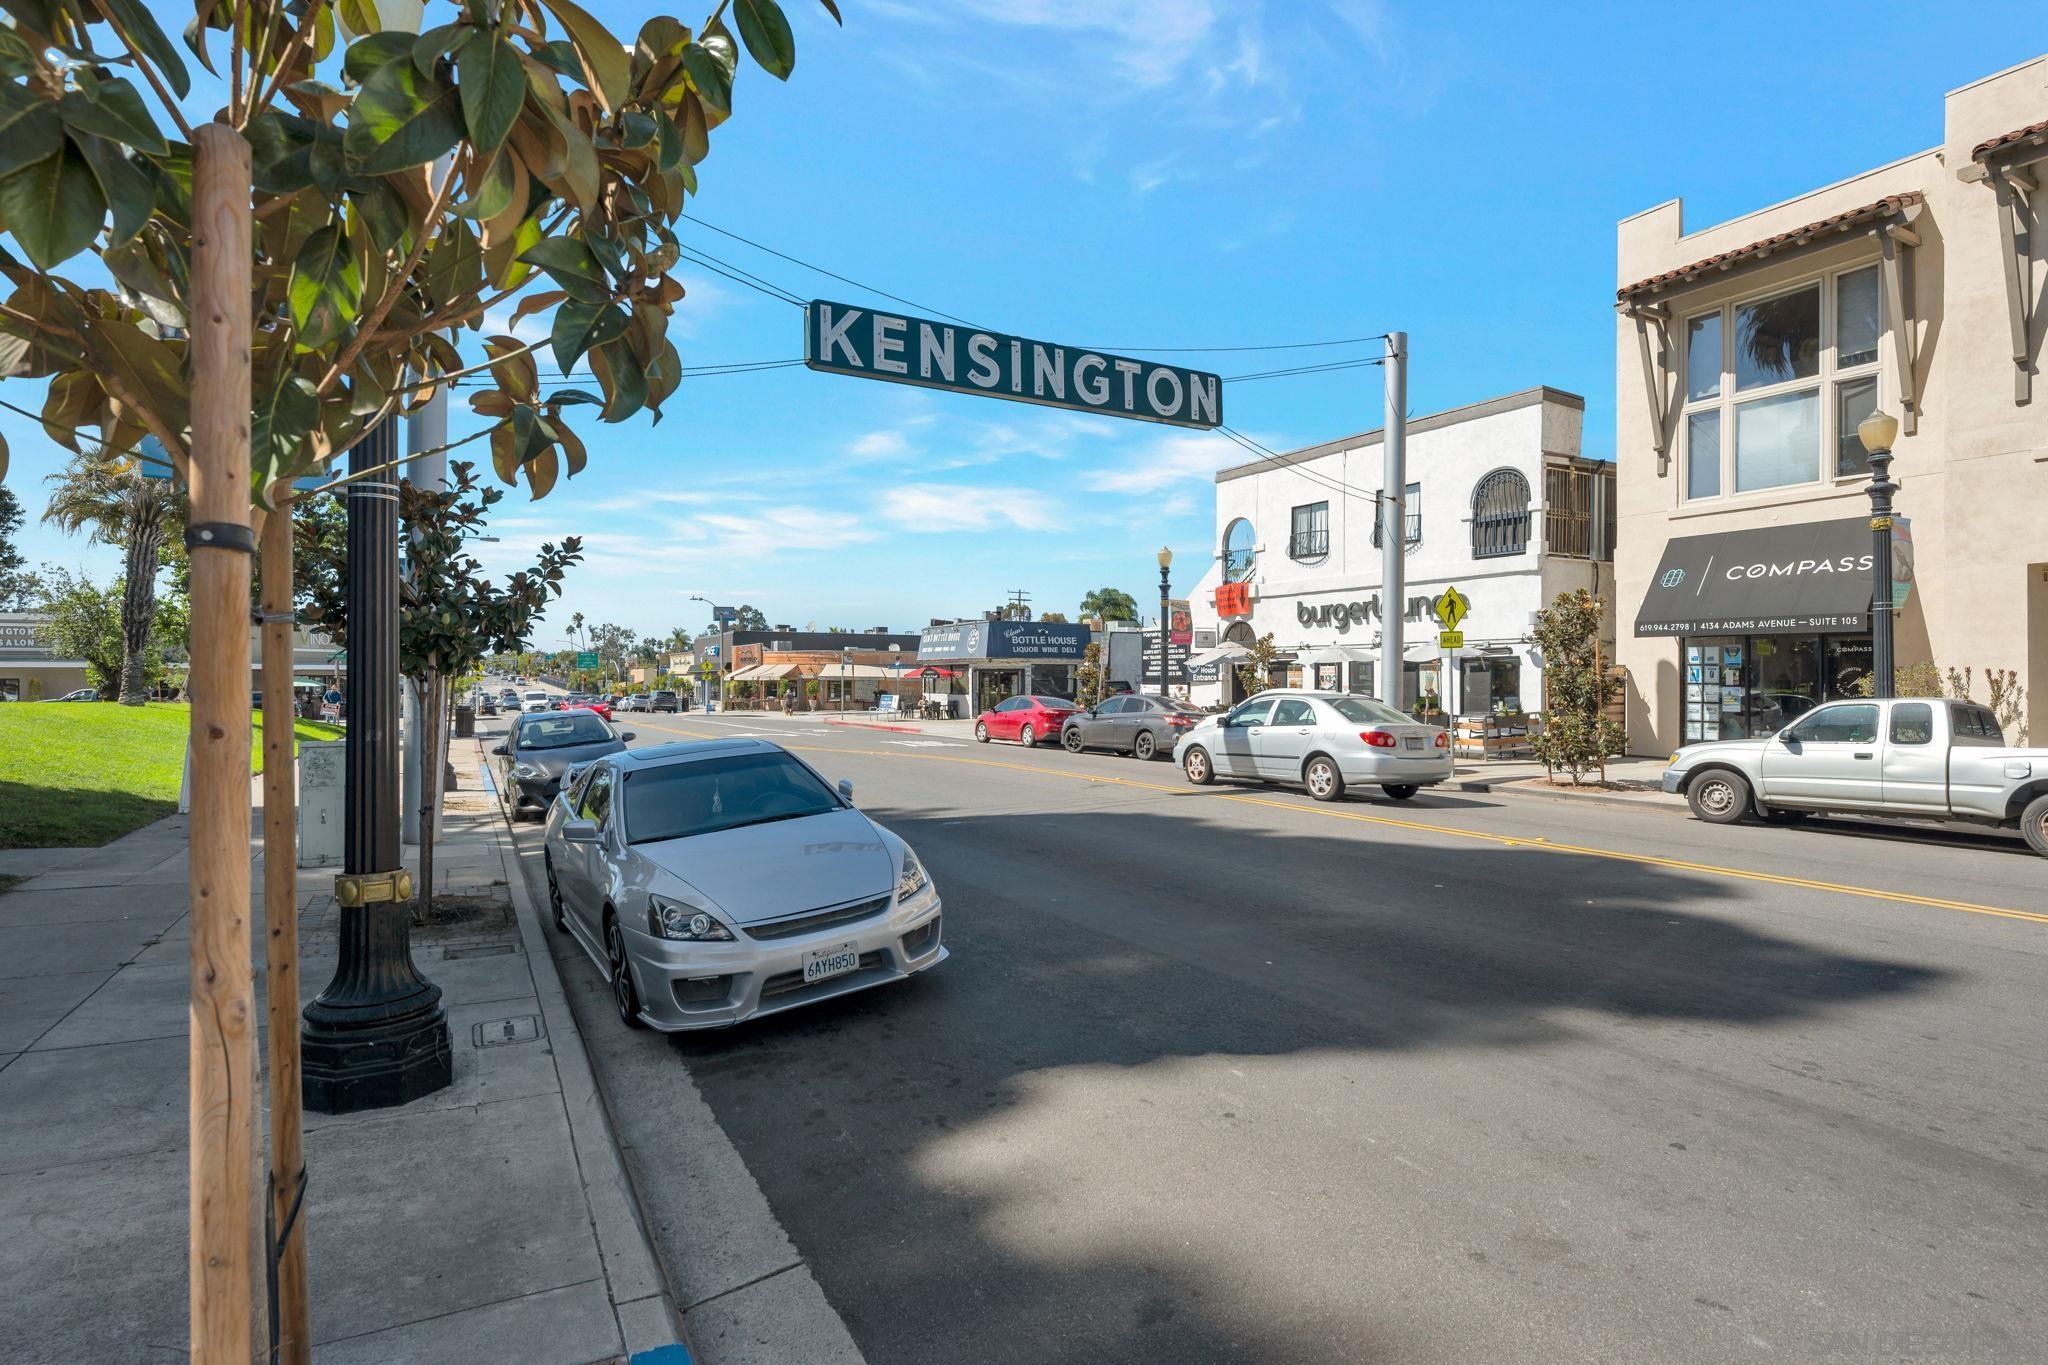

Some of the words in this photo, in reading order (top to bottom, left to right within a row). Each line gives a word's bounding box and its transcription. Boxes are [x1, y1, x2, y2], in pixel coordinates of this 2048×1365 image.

[819, 304, 1217, 424] KENSINGTON
[1726, 555, 1874, 580] COMPASS
[1639, 623, 1690, 632] 619.944.2798
[1700, 621, 1720, 630] 4134
[1723, 620, 1755, 629] ADAMS
[1758, 618, 1796, 628] AVENUE
[1809, 617, 1837, 626] SUITE
[1842, 616, 1858, 625] 105
[1012, 636, 1046, 645] BOTTLE
[1047, 636, 1078, 645] HOUSE
[1442, 635, 1461, 645] AHEAD
[808, 953, 855, 976] 6AYH850
